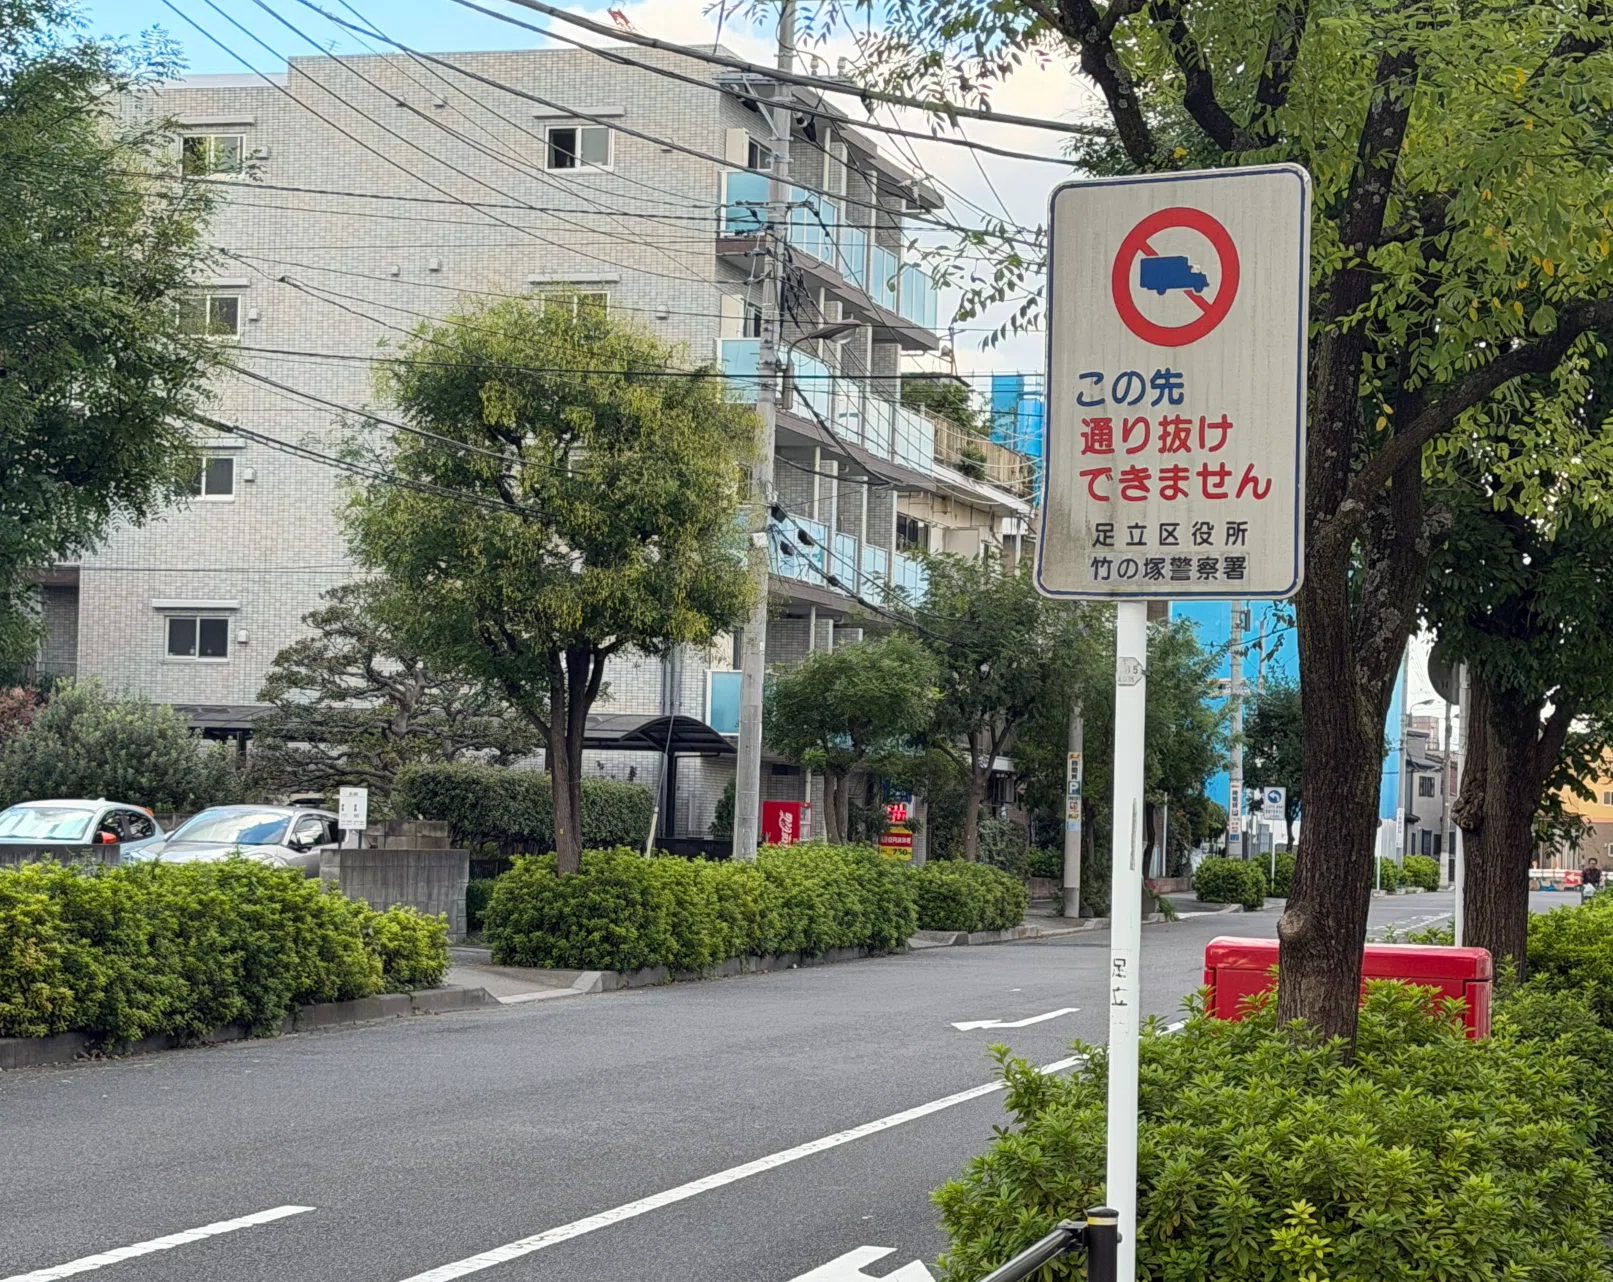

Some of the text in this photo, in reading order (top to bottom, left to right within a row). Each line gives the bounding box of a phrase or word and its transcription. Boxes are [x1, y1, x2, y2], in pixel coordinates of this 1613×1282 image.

[1076, 367, 1185, 408] この先
[1080, 413, 1234, 455] 通り抜け
[1079, 461, 1273, 502] できません
[1092, 521, 1249, 547] 足立区役所
[1090, 556, 1247, 581] 竹の塚警察署
